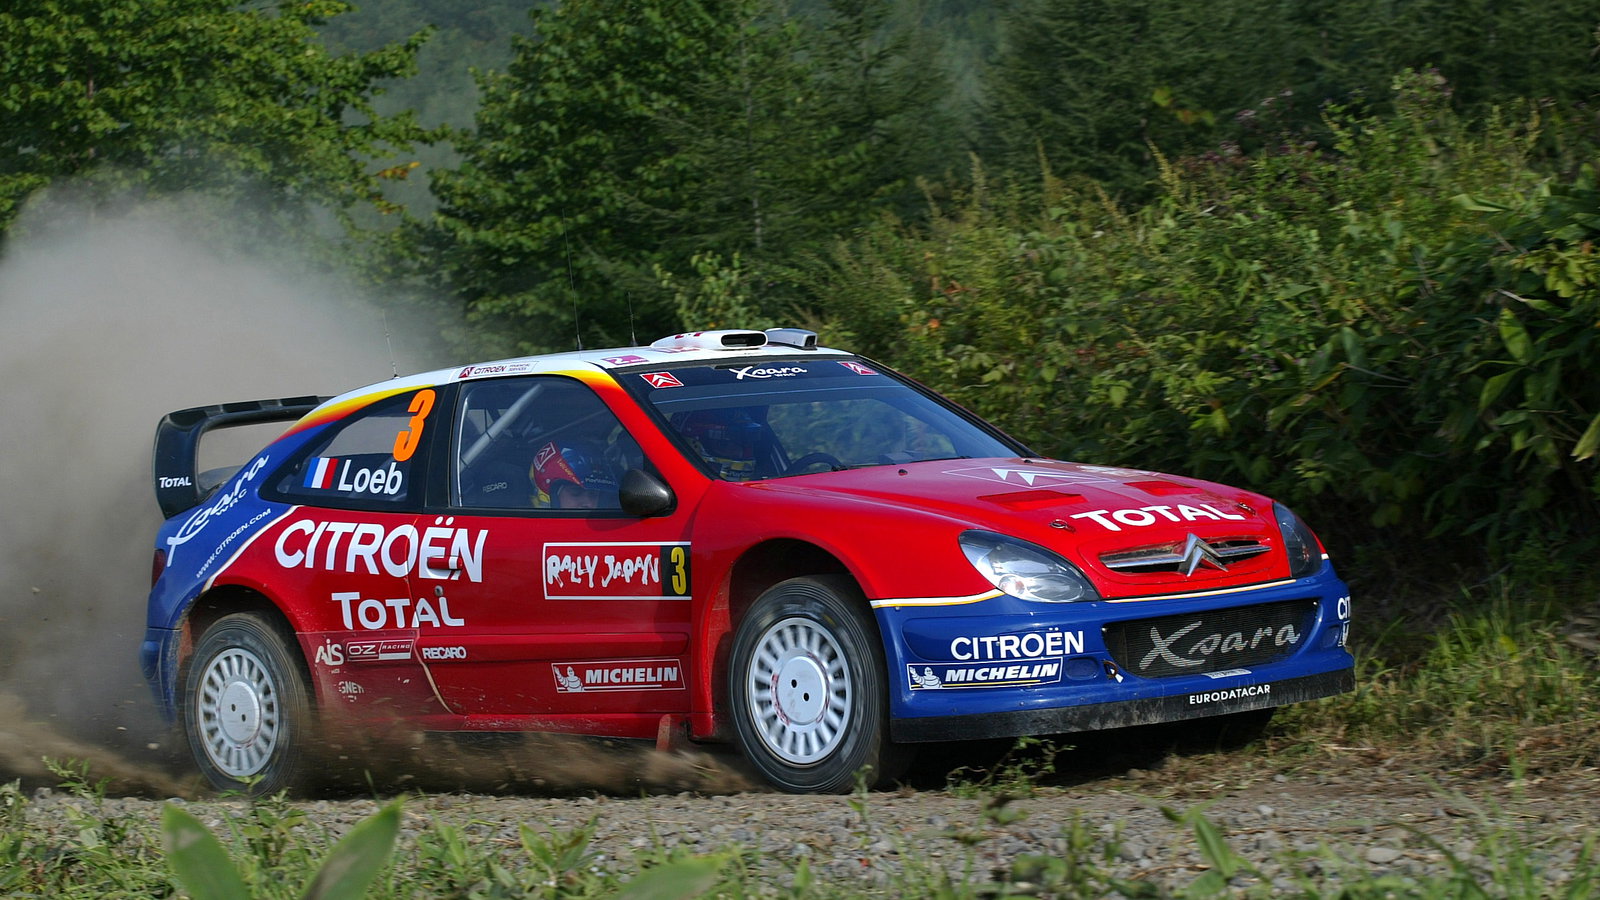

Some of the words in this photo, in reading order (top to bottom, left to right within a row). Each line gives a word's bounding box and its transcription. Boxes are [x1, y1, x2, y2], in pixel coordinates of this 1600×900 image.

[728, 365, 808, 380] Xsara
[393, 389, 436, 462] 3
[159, 476, 192, 489] TOTAL
[337, 459, 403, 495] Loeb
[1069, 503, 1246, 532] TOTAL
[196, 508, 271, 578] WWW.CITROEN.COM
[274, 516, 488, 583] CITROËN
[546, 554, 599, 588] RALLY
[601, 554, 660, 588] JAPAN
[670, 546, 687, 595] 3
[331, 592, 465, 630] TOTAL
[422, 646, 467, 659] RECARO
[950, 627, 1084, 661] CITROËN
[1139, 620, 1301, 671] Xsara
[585, 667, 678, 684] MICHELIN
[945, 663, 1059, 682] MICHELIN
[1188, 684, 1271, 705] EURODATACAR
